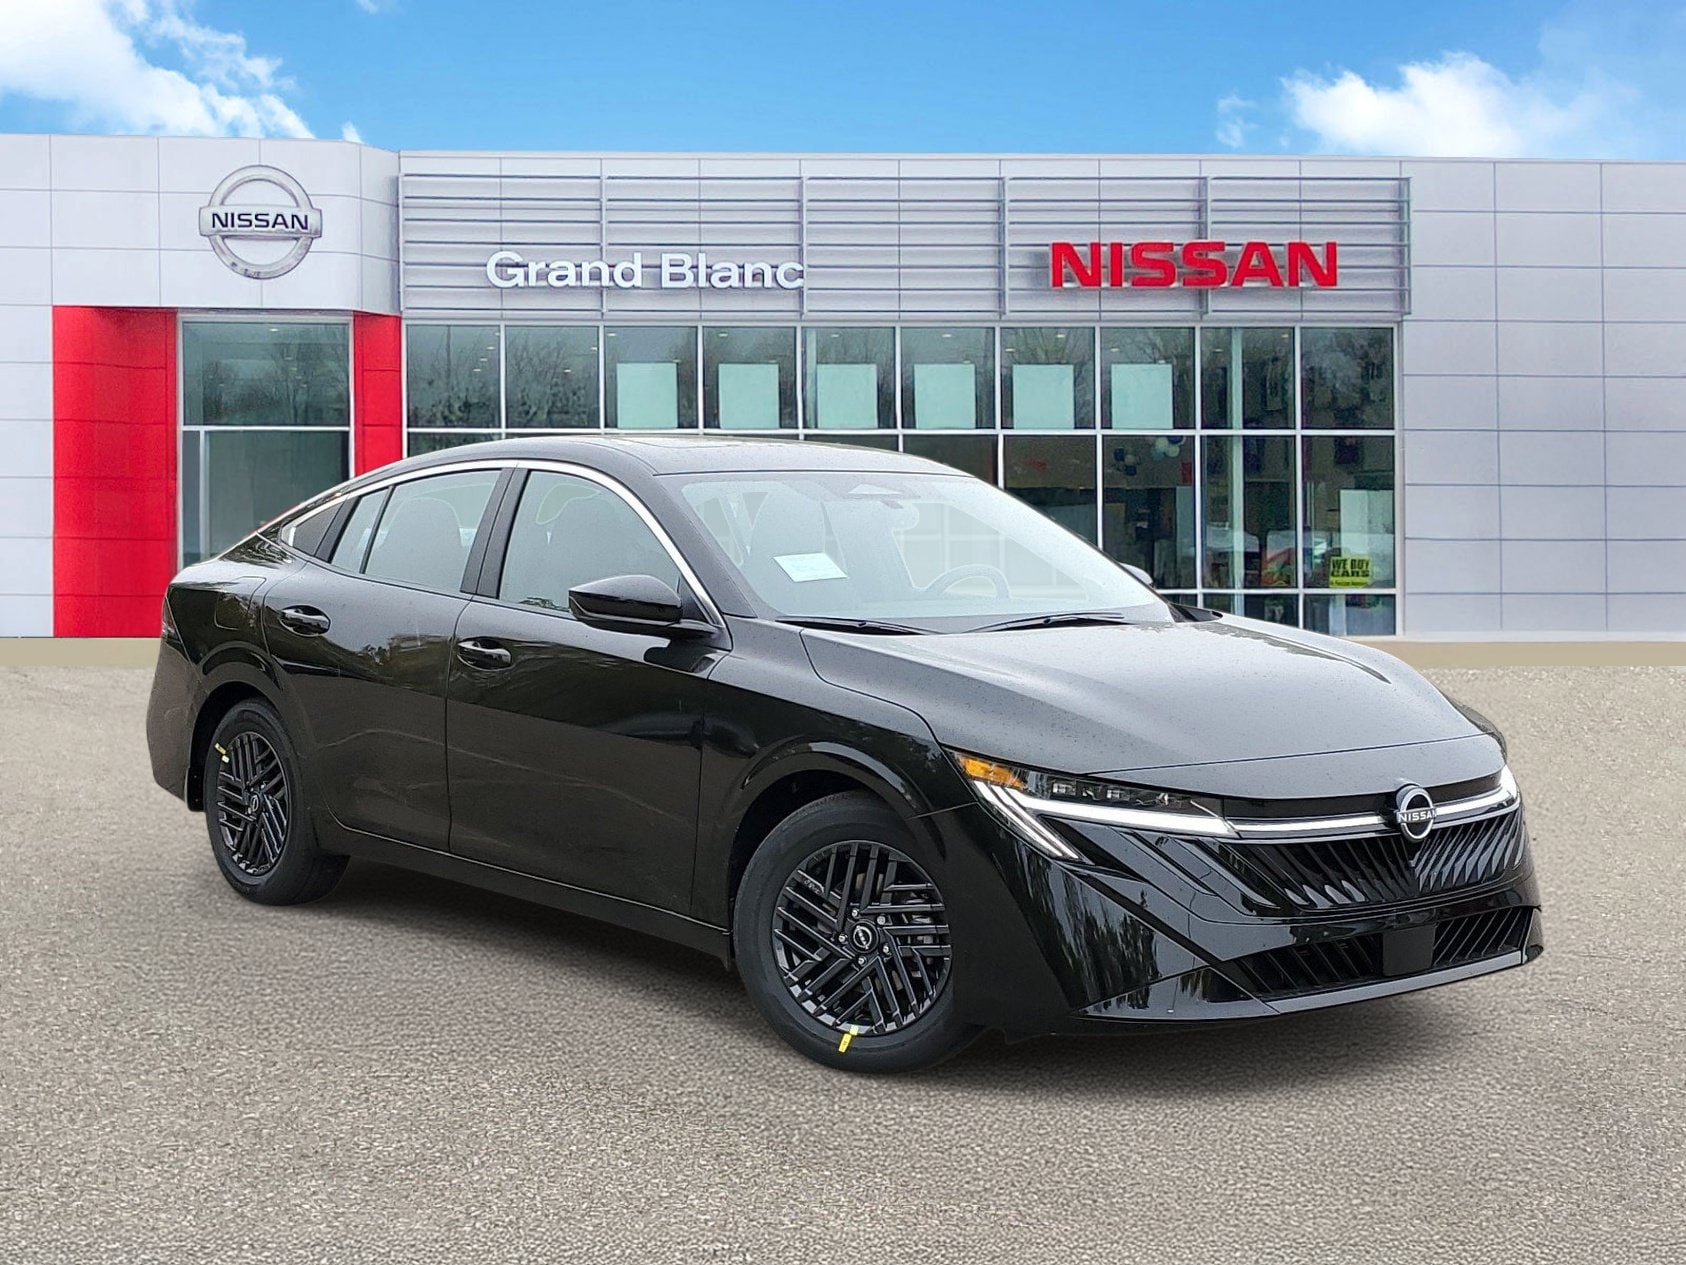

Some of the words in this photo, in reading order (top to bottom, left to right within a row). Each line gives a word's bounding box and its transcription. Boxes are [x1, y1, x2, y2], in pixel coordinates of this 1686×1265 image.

[211, 212, 309, 230] NISSAN
[486, 250, 643, 288] Grand
[660, 252, 804, 289] Blanc
[1051, 241, 1338, 287] NISSAN
[1332, 559, 1348, 569] WE
[1350, 559, 1370, 569] BUY
[1398, 809, 1436, 822] NISSAN
